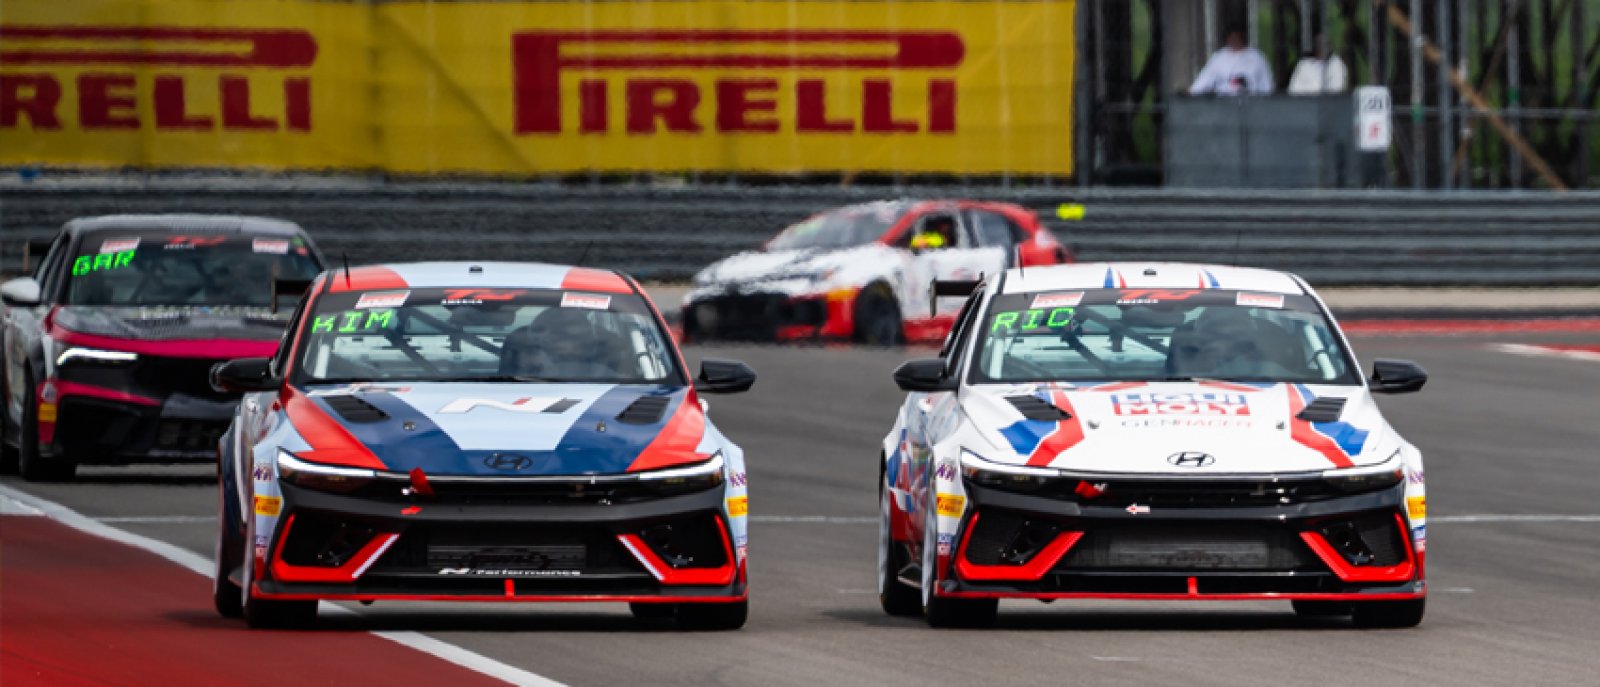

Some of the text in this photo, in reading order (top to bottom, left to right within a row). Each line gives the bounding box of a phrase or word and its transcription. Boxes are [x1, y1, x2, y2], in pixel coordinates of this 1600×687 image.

[0, 28, 318, 131] RELLI
[512, 31, 965, 135] PIRELLI
[312, 309, 392, 333] KIM
[992, 307, 1076, 332] RIC
[1114, 403, 1250, 416] MOLY
